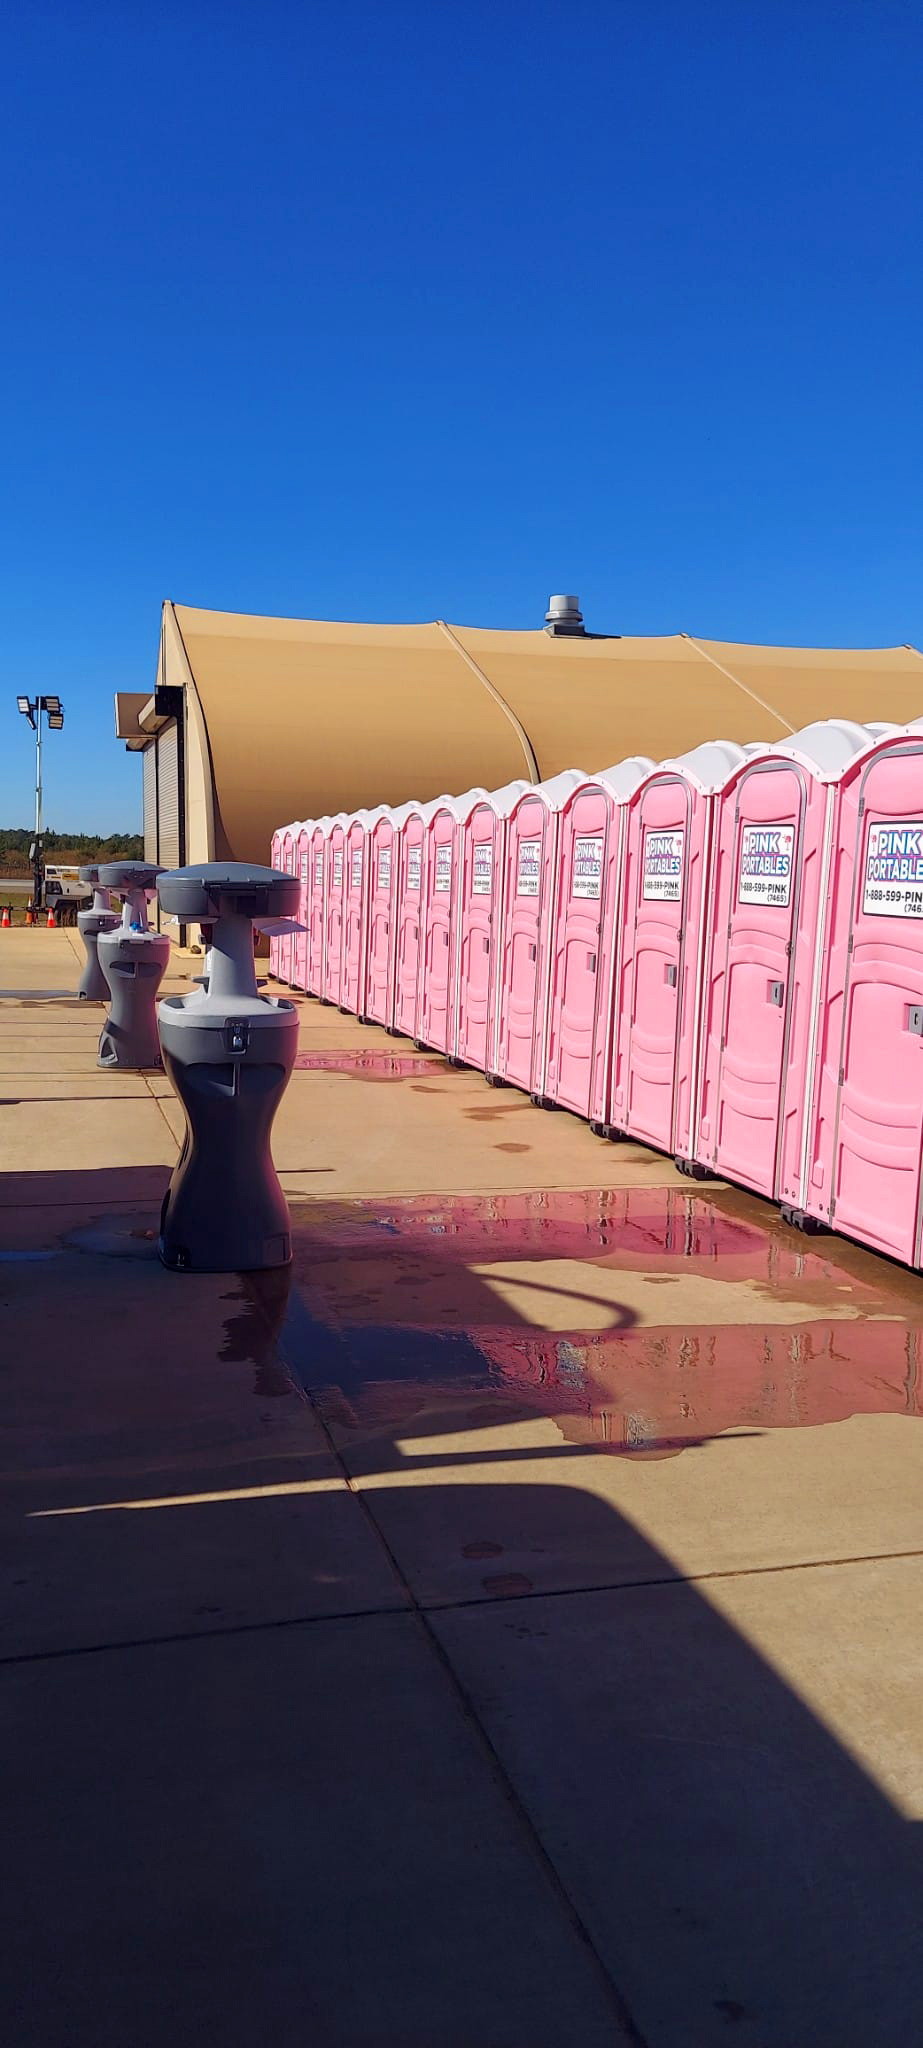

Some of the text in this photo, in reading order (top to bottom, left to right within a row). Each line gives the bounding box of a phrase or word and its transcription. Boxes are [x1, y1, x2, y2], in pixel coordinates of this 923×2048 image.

[649, 837, 674, 857] PINK
[748, 832, 781, 854] PINK
[878, 830, 922, 855] PINK
[742, 853, 791, 877] PORTABLES
[867, 855, 923, 882] PORTABLE
[865, 889, 923, 903] 1-888-599-PIN
[904, 904, 923, 913] (746
